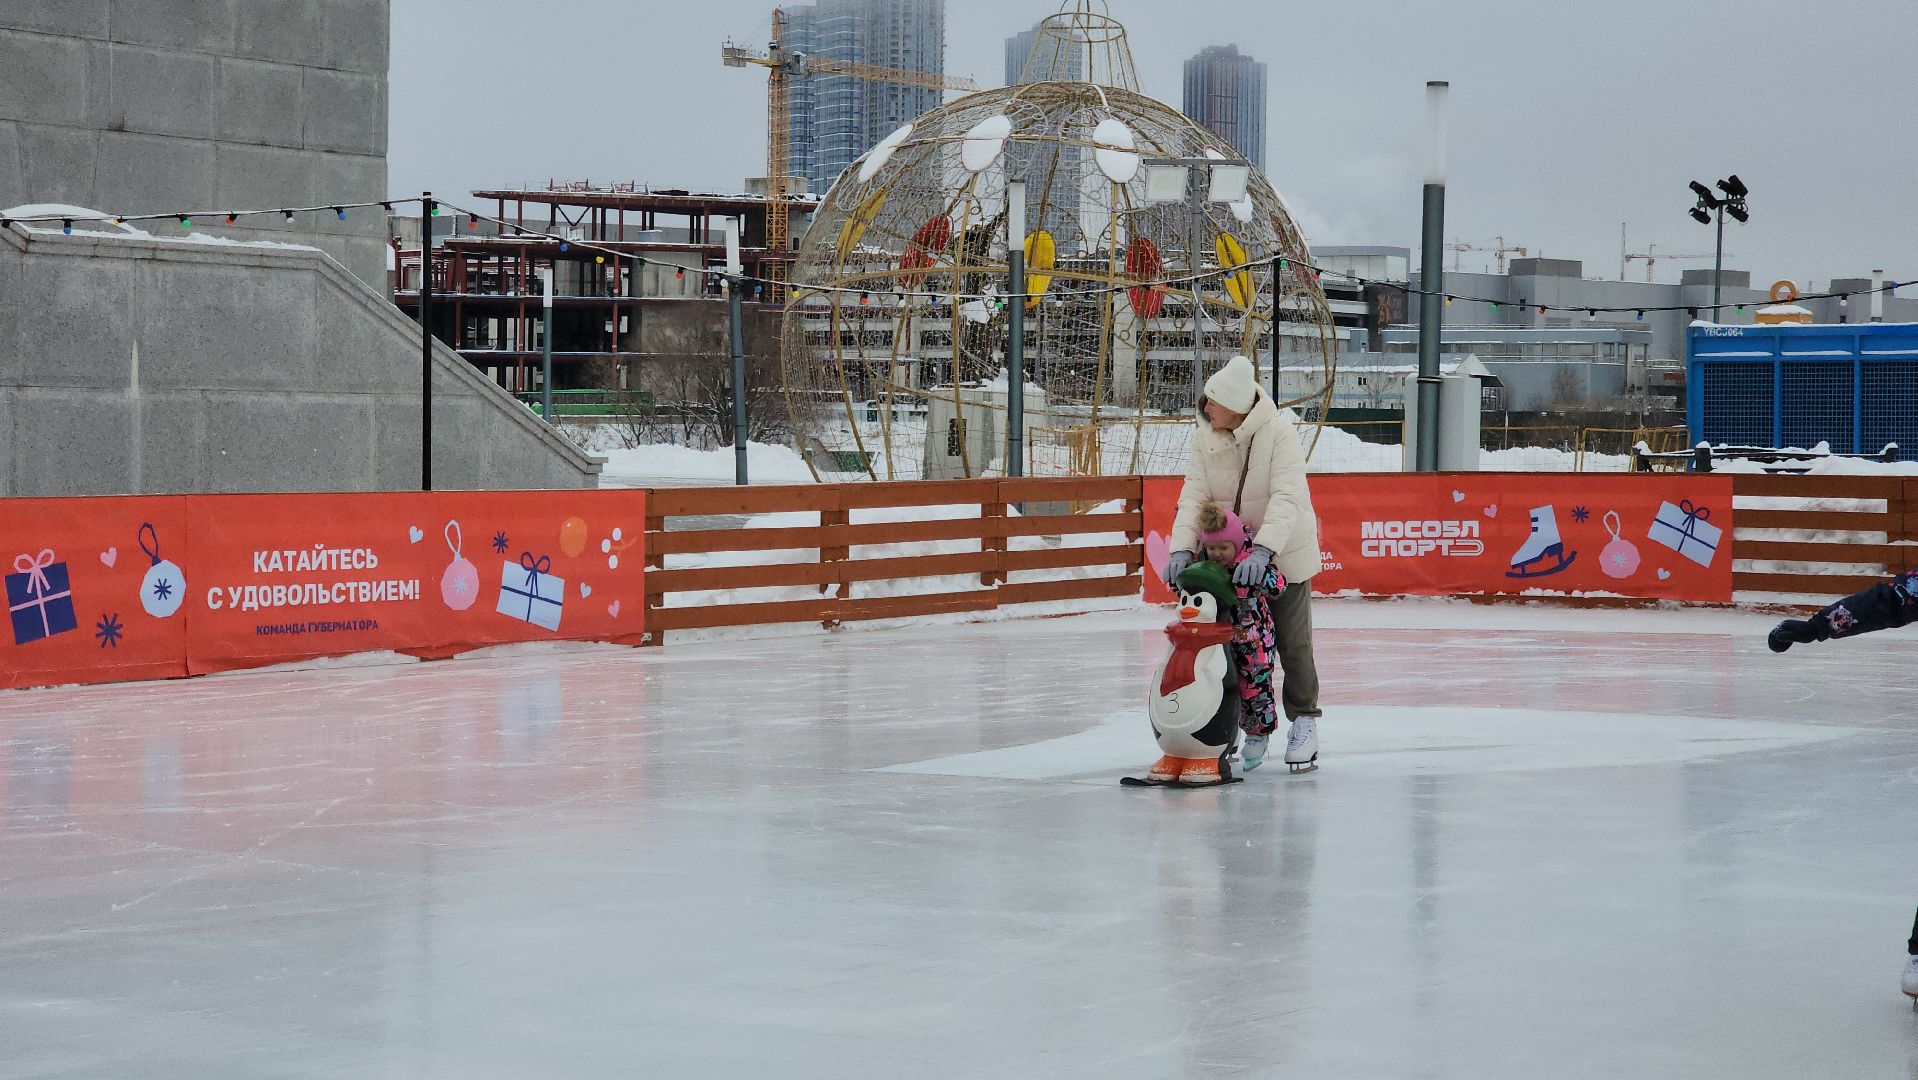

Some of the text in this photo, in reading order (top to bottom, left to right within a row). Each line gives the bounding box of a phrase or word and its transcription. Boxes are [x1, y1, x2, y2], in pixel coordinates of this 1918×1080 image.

[1361, 520, 1479, 539] МОСОБЛ
[253, 543, 379, 573] КАТАЙТЕСЬ
[1361, 539, 1484, 557] СПОРТ
[207, 579, 420, 612] С УДОВОЛЬСТВИЕМ!
[256, 619, 379, 636] КОМАНДА ГУБЕРНАТОРА
[1168, 692, 1180, 714] 3
